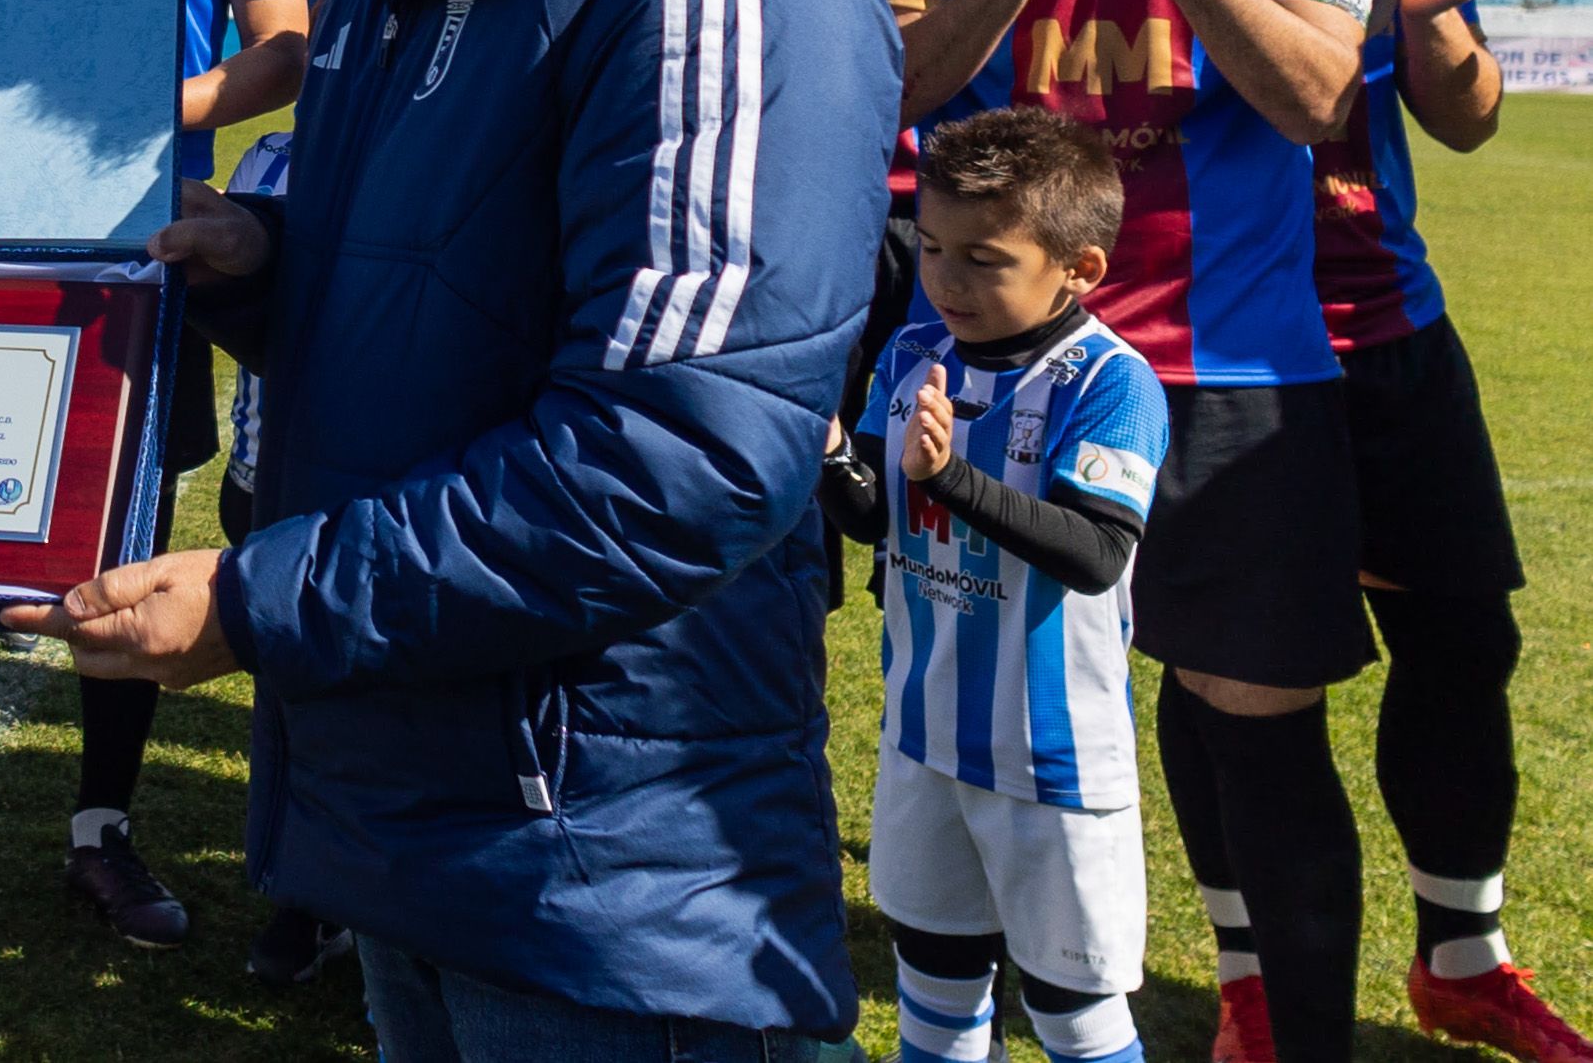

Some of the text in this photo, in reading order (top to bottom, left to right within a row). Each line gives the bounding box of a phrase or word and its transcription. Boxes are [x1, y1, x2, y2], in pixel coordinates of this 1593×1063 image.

[1027, 18, 1173, 95] MM
[889, 552, 1009, 601] MundoMÓVIL
[918, 581, 973, 614] Network
